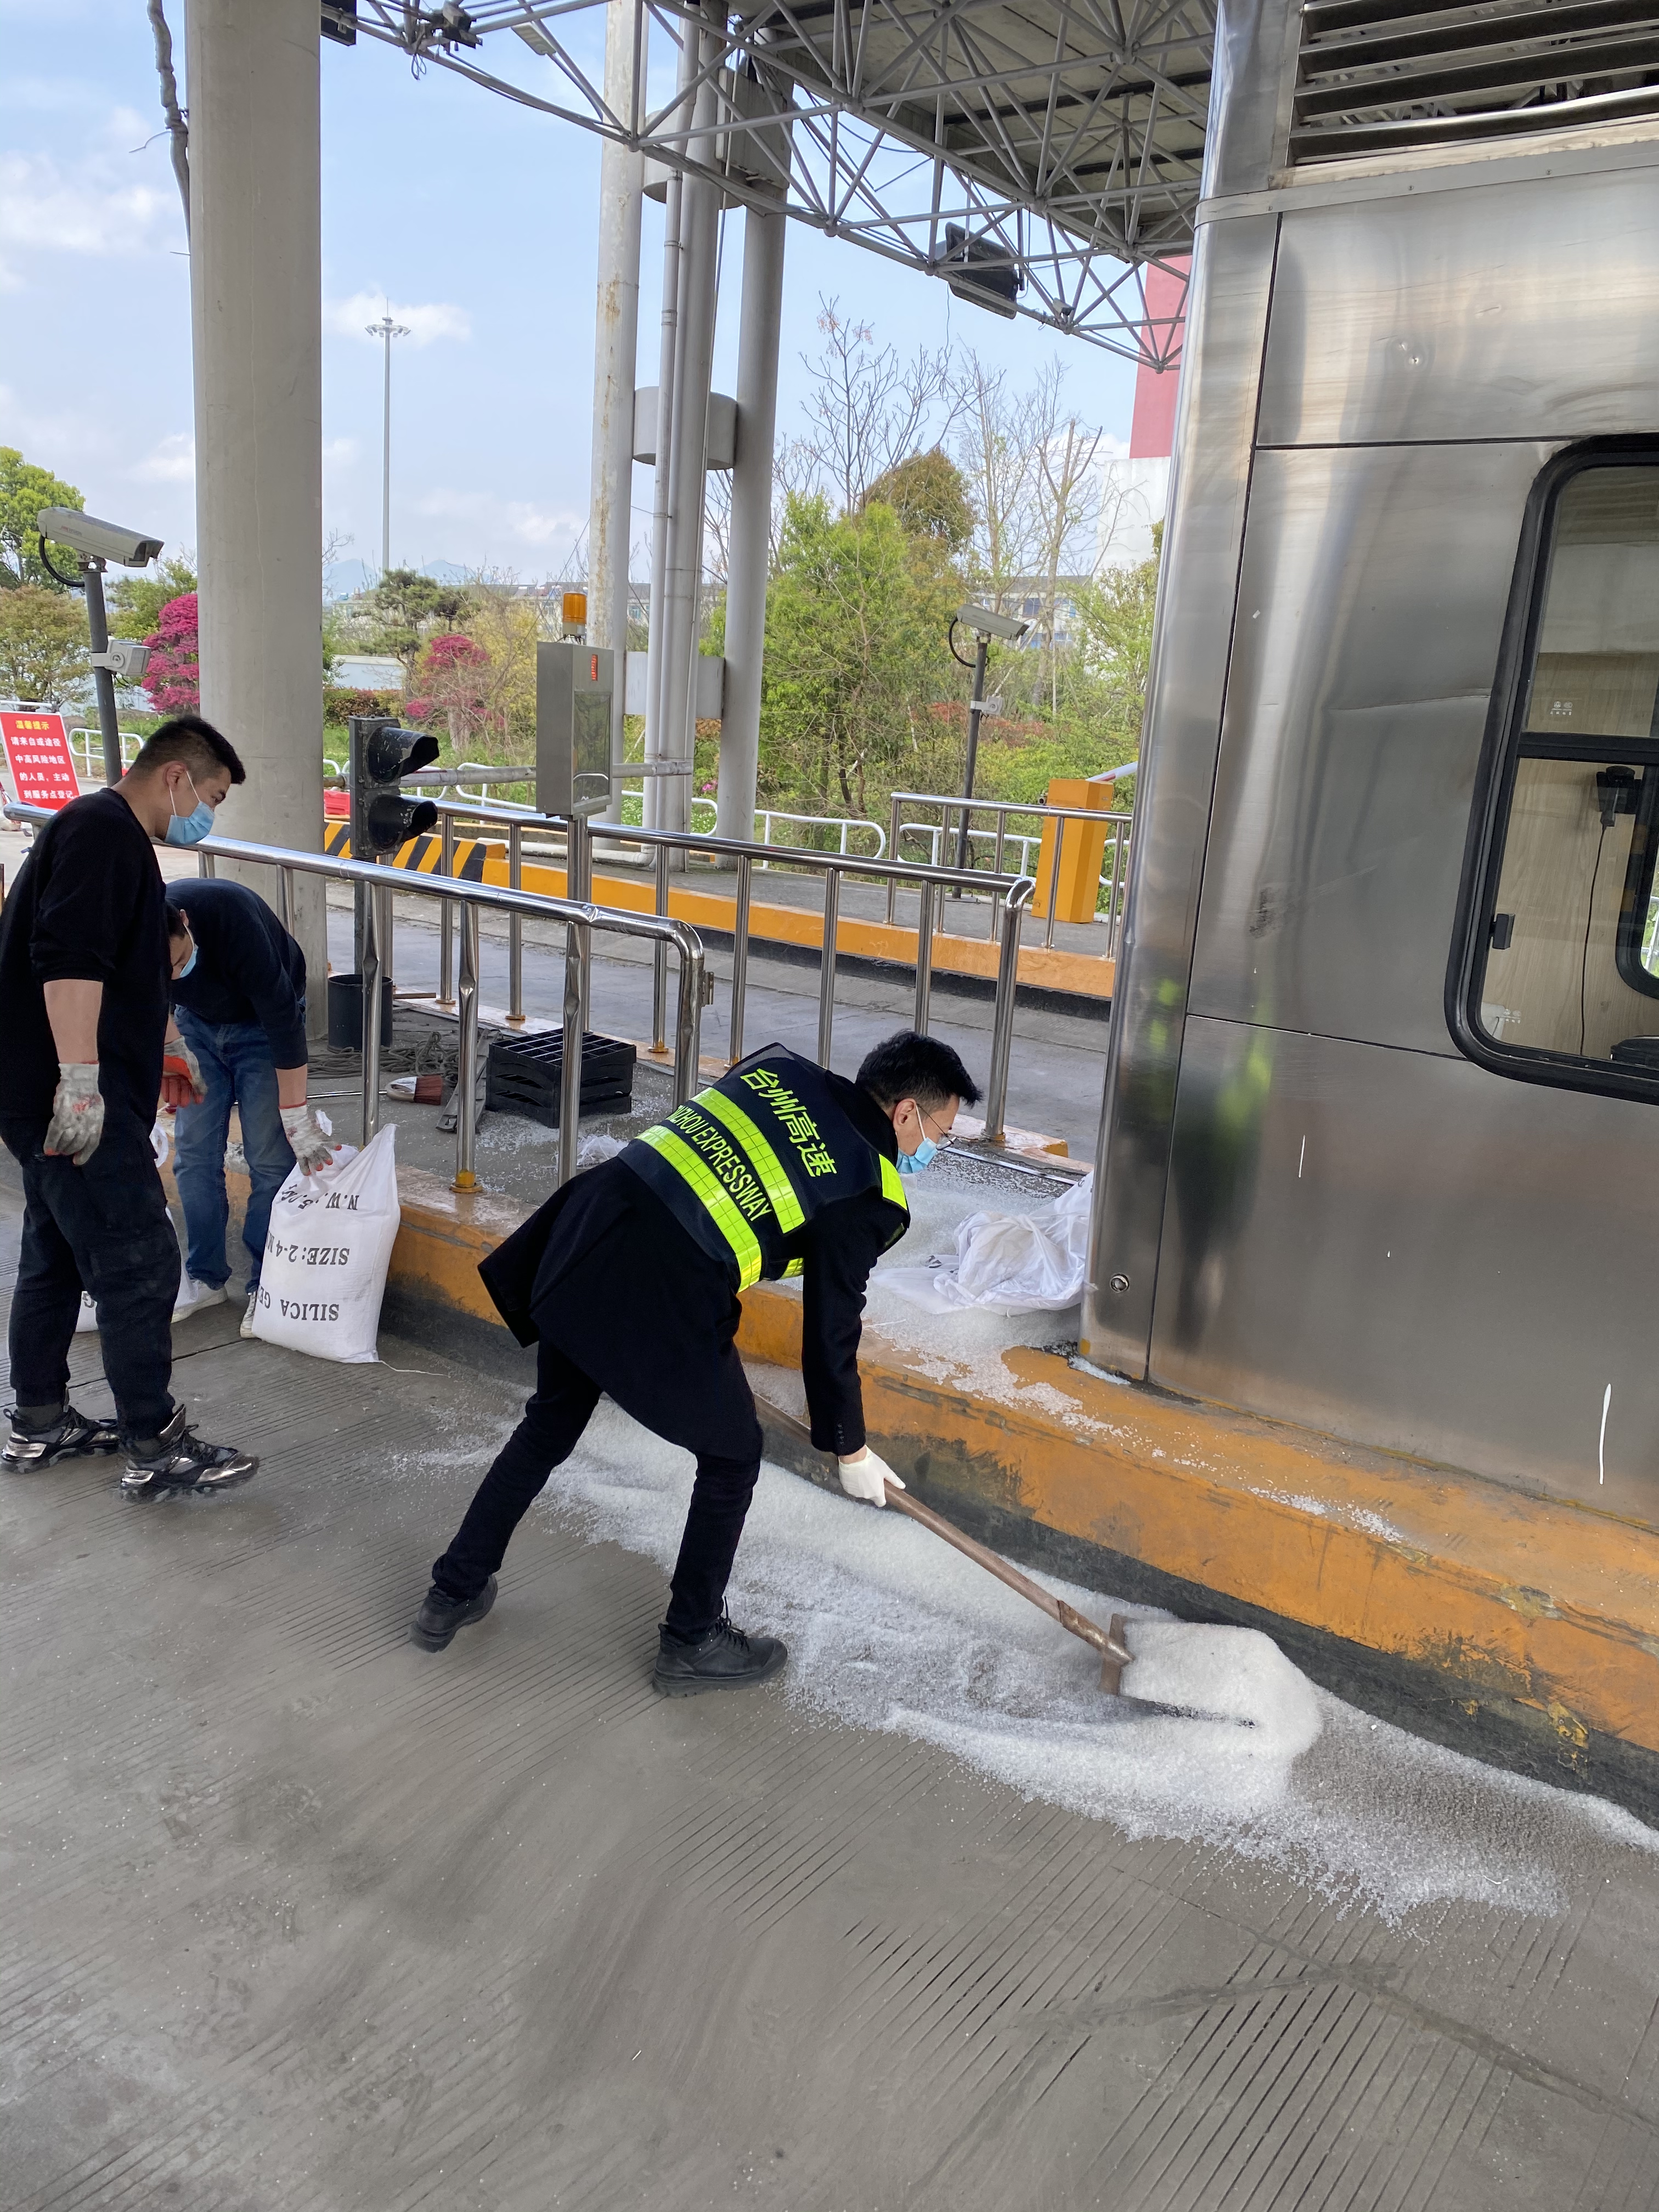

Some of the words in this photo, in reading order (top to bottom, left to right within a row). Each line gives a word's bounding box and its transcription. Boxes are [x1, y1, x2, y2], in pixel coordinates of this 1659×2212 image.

[15, 720, 49, 730] 温馨提示
[10, 736, 61, 747] 请来自或途径
[15, 754, 65, 764] 中高风险地区
[740, 1068, 837, 1177] 台州高速
[691, 1126, 772, 1221] EXPRESSWAY
[266, 1230, 275, 1253] M
[258, 1284, 270, 1309] GE
[280, 1299, 339, 1321] SILICA
